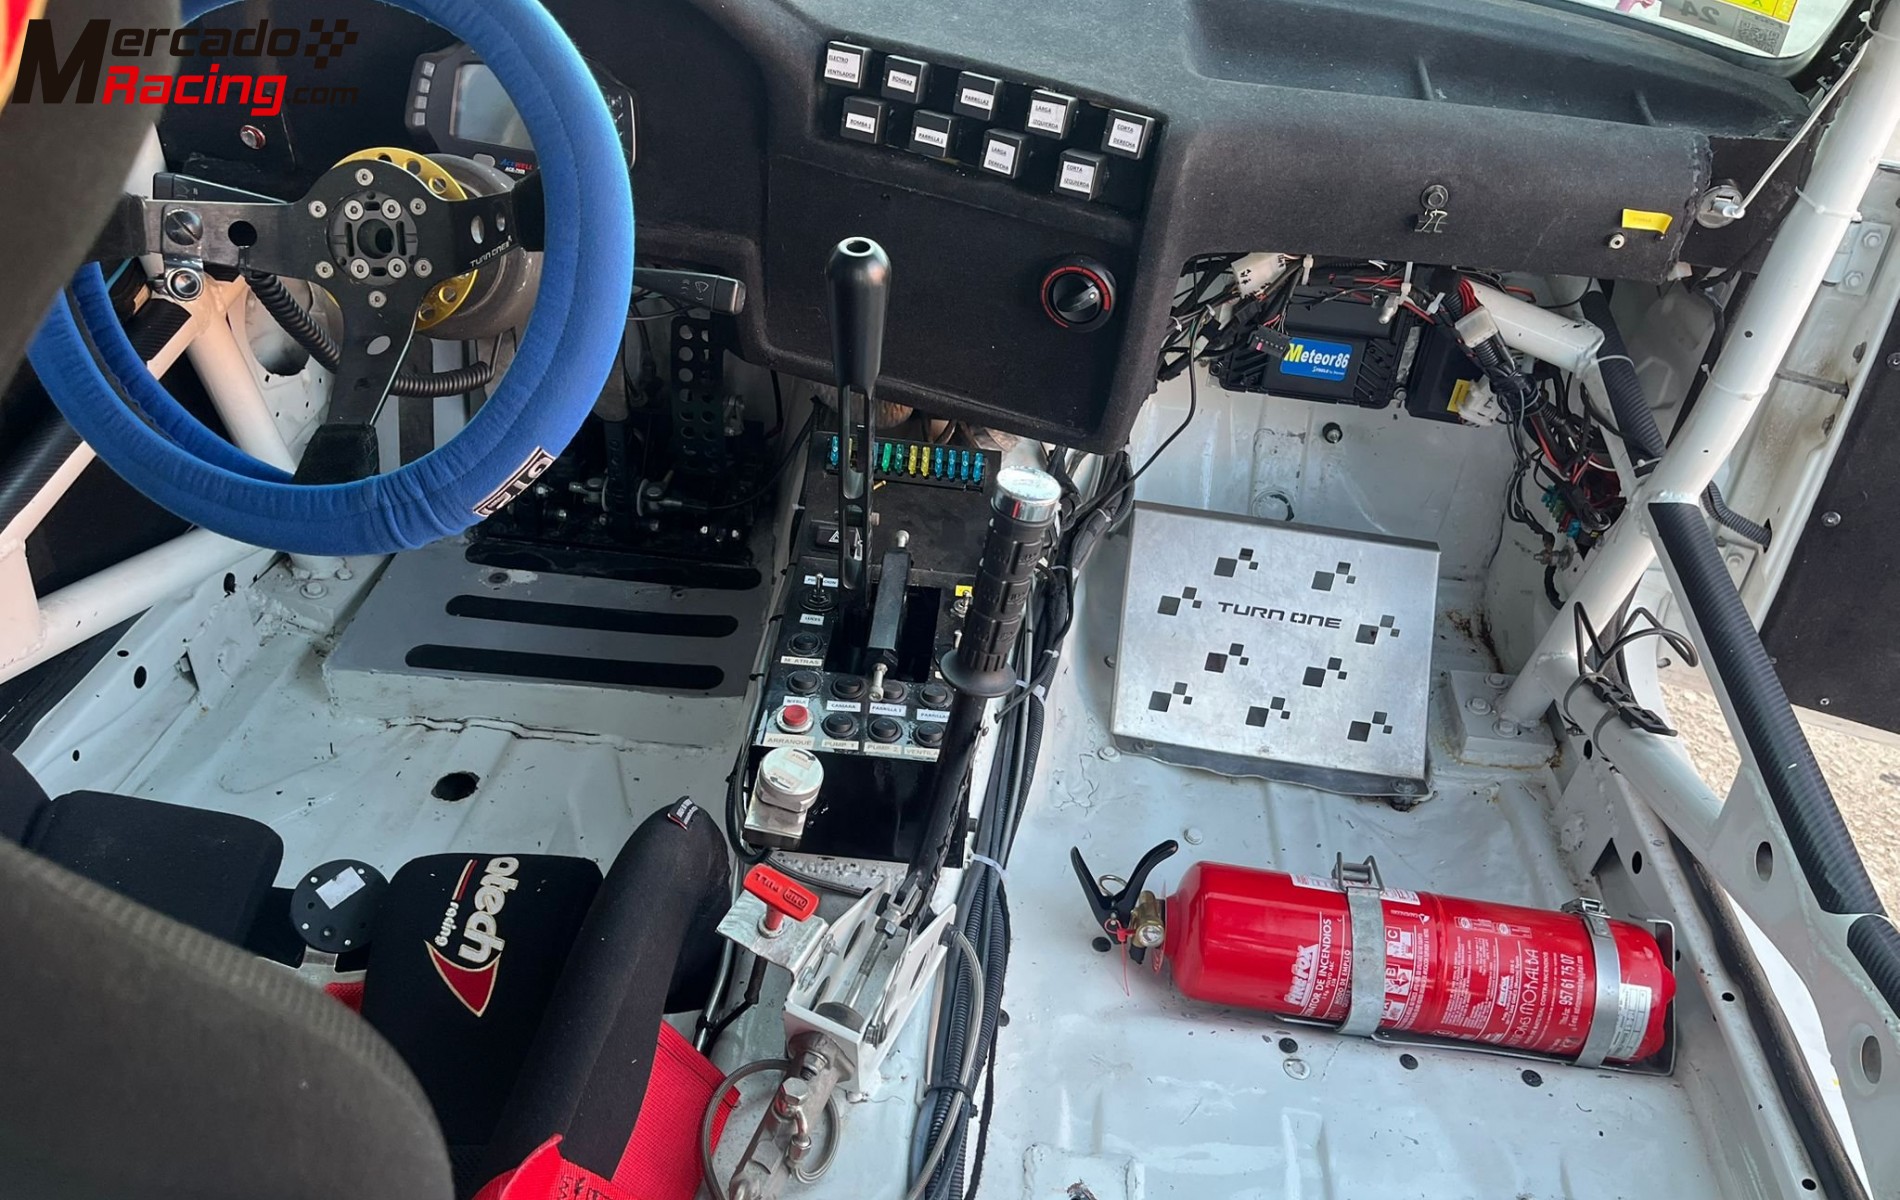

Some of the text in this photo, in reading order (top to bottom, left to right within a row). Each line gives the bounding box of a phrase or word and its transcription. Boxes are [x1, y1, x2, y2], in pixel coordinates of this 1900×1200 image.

[826, 69, 856, 79] VENTILADOR
[850, 118, 868, 128] BOMBA
[1032, 118, 1059, 129] IZQUIERDA
[1117, 124, 1134, 133] CORTA
[1113, 138, 1136, 149] DERECHA
[987, 160, 1009, 171] DERECHA
[1066, 164, 1083, 173] CORTA
[1063, 178, 1090, 188] IZQUIERDA
[1284, 343, 1350, 369] Meteor86
[1218, 601, 1342, 629] TURN ONE
[767, 737, 812, 746] ARRANQUE
[755, 872, 780, 893] PULL
[435, 901, 459, 947] racing
[1387, 929, 1399, 940] C
[1318, 918, 1331, 977] INCENDIOS
[1560, 953, 1575, 965] 07
[1560, 965, 1575, 976] 75
[1325, 972, 1333, 988] POLVO
[1334, 949, 1350, 1005] MODO DE EMPLEO
[1316, 979, 1325, 991] DE
[1560, 978, 1575, 989] 61
[1540, 981, 1549, 1006] CONTRA
[1559, 989, 1573, 1006] 957
